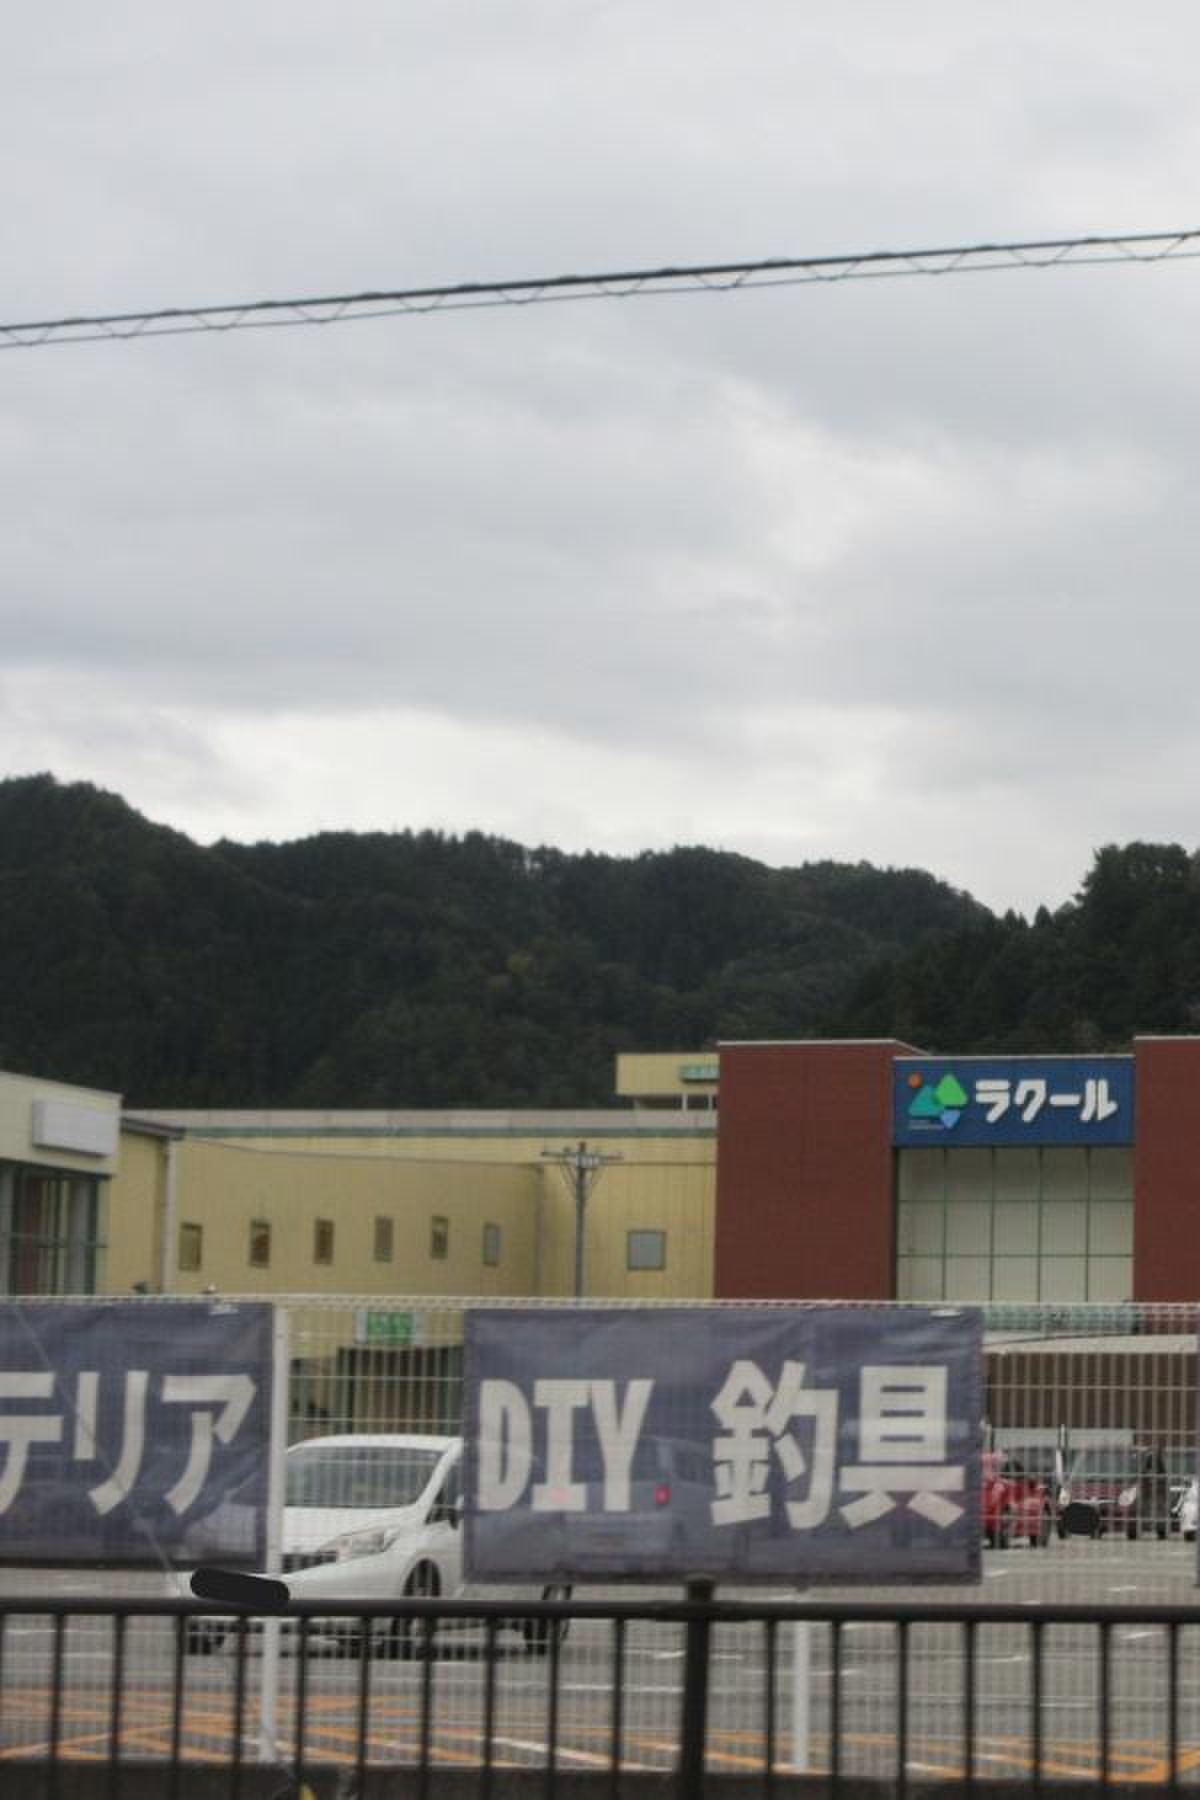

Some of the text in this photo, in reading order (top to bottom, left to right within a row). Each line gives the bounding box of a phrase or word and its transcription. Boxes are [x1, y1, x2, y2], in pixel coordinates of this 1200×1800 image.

[975, 1078, 1118, 1123] ラクール
[0, 1370, 257, 1516] テリア
[478, 1359, 966, 1530] DIY 釣具
